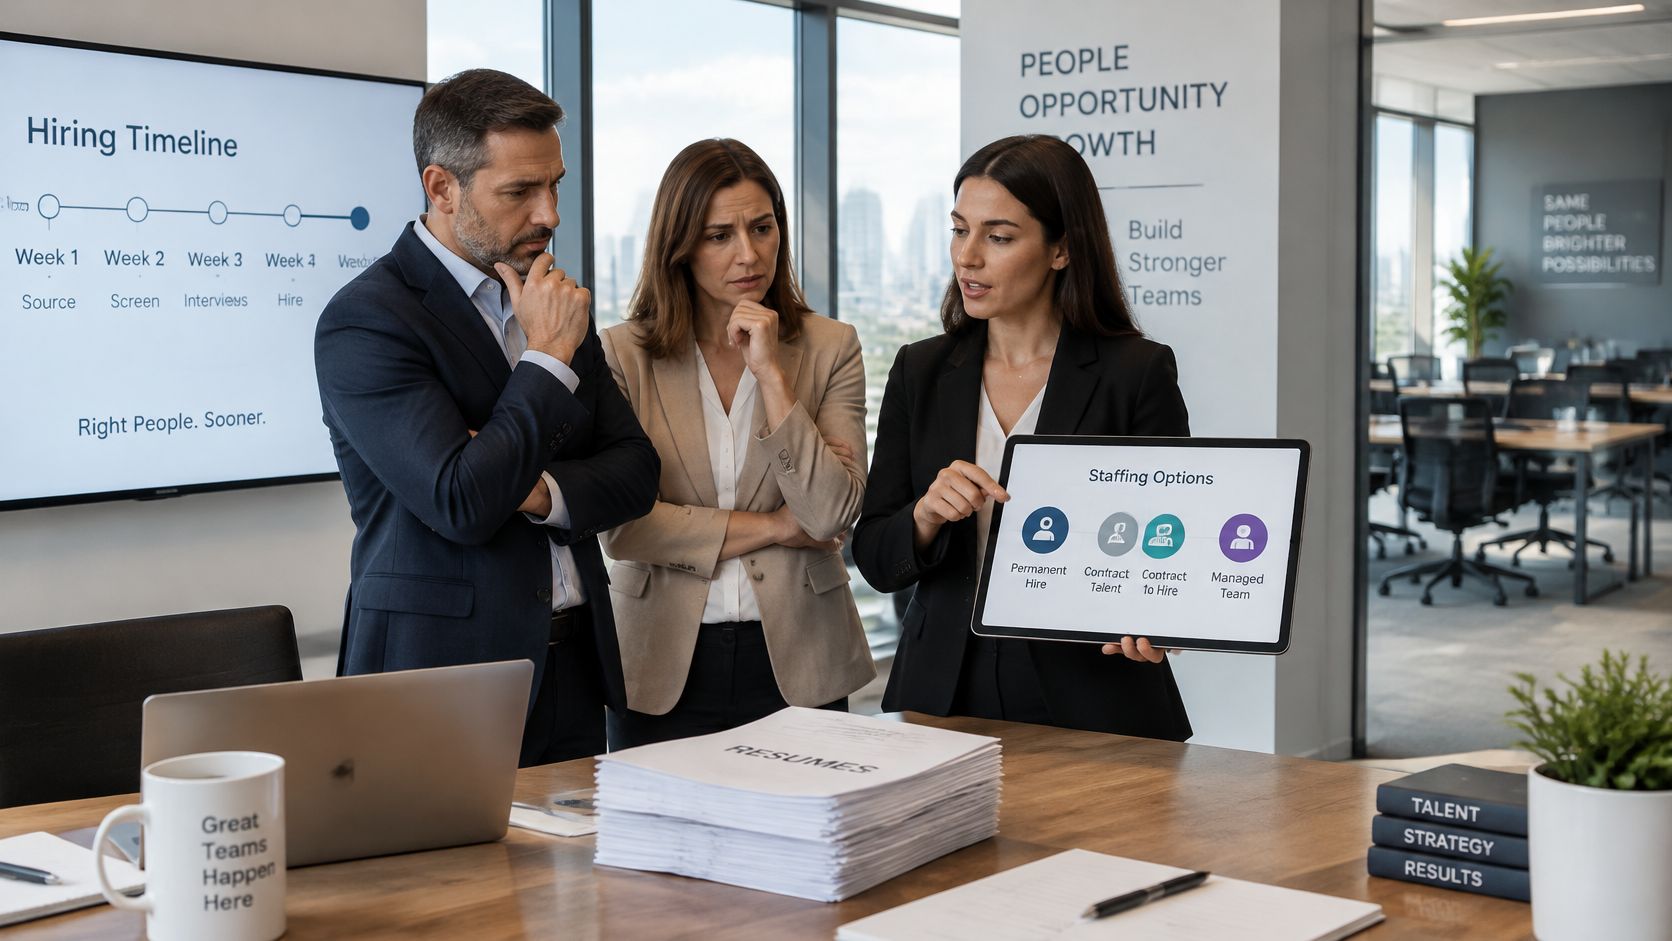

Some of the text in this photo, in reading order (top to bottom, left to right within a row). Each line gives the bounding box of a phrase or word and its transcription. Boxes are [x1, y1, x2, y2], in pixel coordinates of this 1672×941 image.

[1022, 45, 1128, 77] PEOPLE
[1020, 82, 1227, 118] OPPORTUNITY
[28, 117, 238, 157] Hiring Timeline
[1066, 130, 1155, 156] OWTH
[1544, 193, 1589, 211] SAME
[1129, 219, 1182, 239] Build
[1543, 214, 1606, 231] PEOPLE
[1542, 234, 1626, 252] BRIGHTER
[15, 248, 77, 265] Week 1
[104, 250, 164, 266] Week 2
[188, 252, 242, 266] Week 3
[266, 253, 303, 267] Week
[1129, 252, 1226, 277] Stronger
[23, 294, 75, 309] Source
[111, 294, 159, 308] Screen
[278, 293, 303, 306] Hire
[1129, 285, 1202, 306] Teams
[78, 412, 265, 439] Right People. Sooner.
[1089, 469, 1213, 486] Staffing Options
[1011, 563, 1067, 575] Permanent
[1085, 567, 1129, 578] Contract
[1142, 569, 1187, 581] Contract
[1026, 579, 1046, 589] Hire
[1091, 583, 1121, 593] Talent
[1212, 572, 1264, 586] Managed
[1144, 585, 1178, 596] to Hire
[1221, 588, 1250, 599] Team
[724, 745, 879, 774] RESUMES
[1411, 797, 1480, 822] TALENT
[202, 813, 259, 834] Great
[202, 841, 268, 861] Teams
[1404, 828, 1494, 856] STRATEGY
[203, 863, 276, 887] Happen
[1405, 860, 1482, 886] RESULTS
[203, 892, 254, 911] Here
